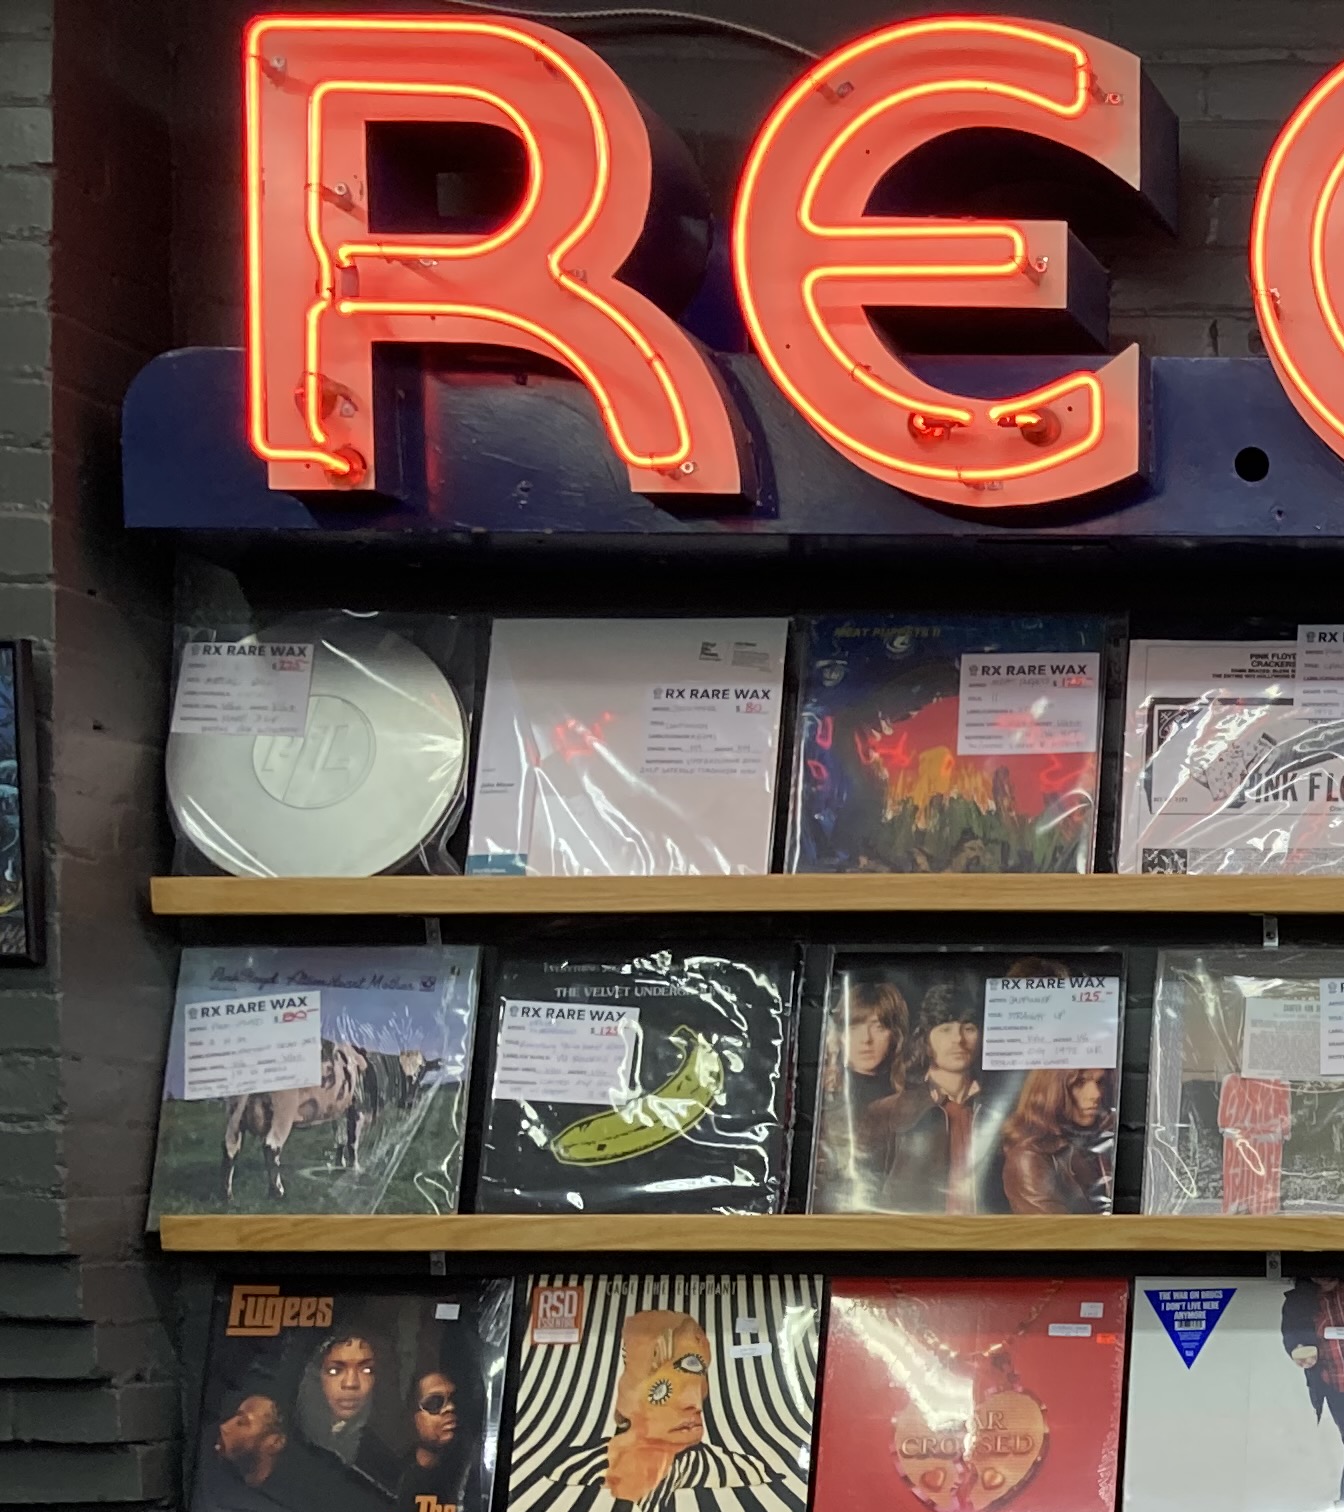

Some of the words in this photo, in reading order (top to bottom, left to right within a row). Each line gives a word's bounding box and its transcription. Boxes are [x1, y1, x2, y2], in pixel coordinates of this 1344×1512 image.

[982, 667, 1001, 676] RX
[1006, 667, 1047, 676] RARE
[1052, 667, 1087, 676] WAX
[1002, 980, 1021, 990] RX
[1026, 979, 1065, 989] RARE
[1070, 979, 1106, 989] WAX
[202, 1006, 220, 1017] RX
[225, 1002, 265, 1014] RARE
[270, 996, 308, 1010] WAX
[226, 1285, 335, 1338] Fugees
